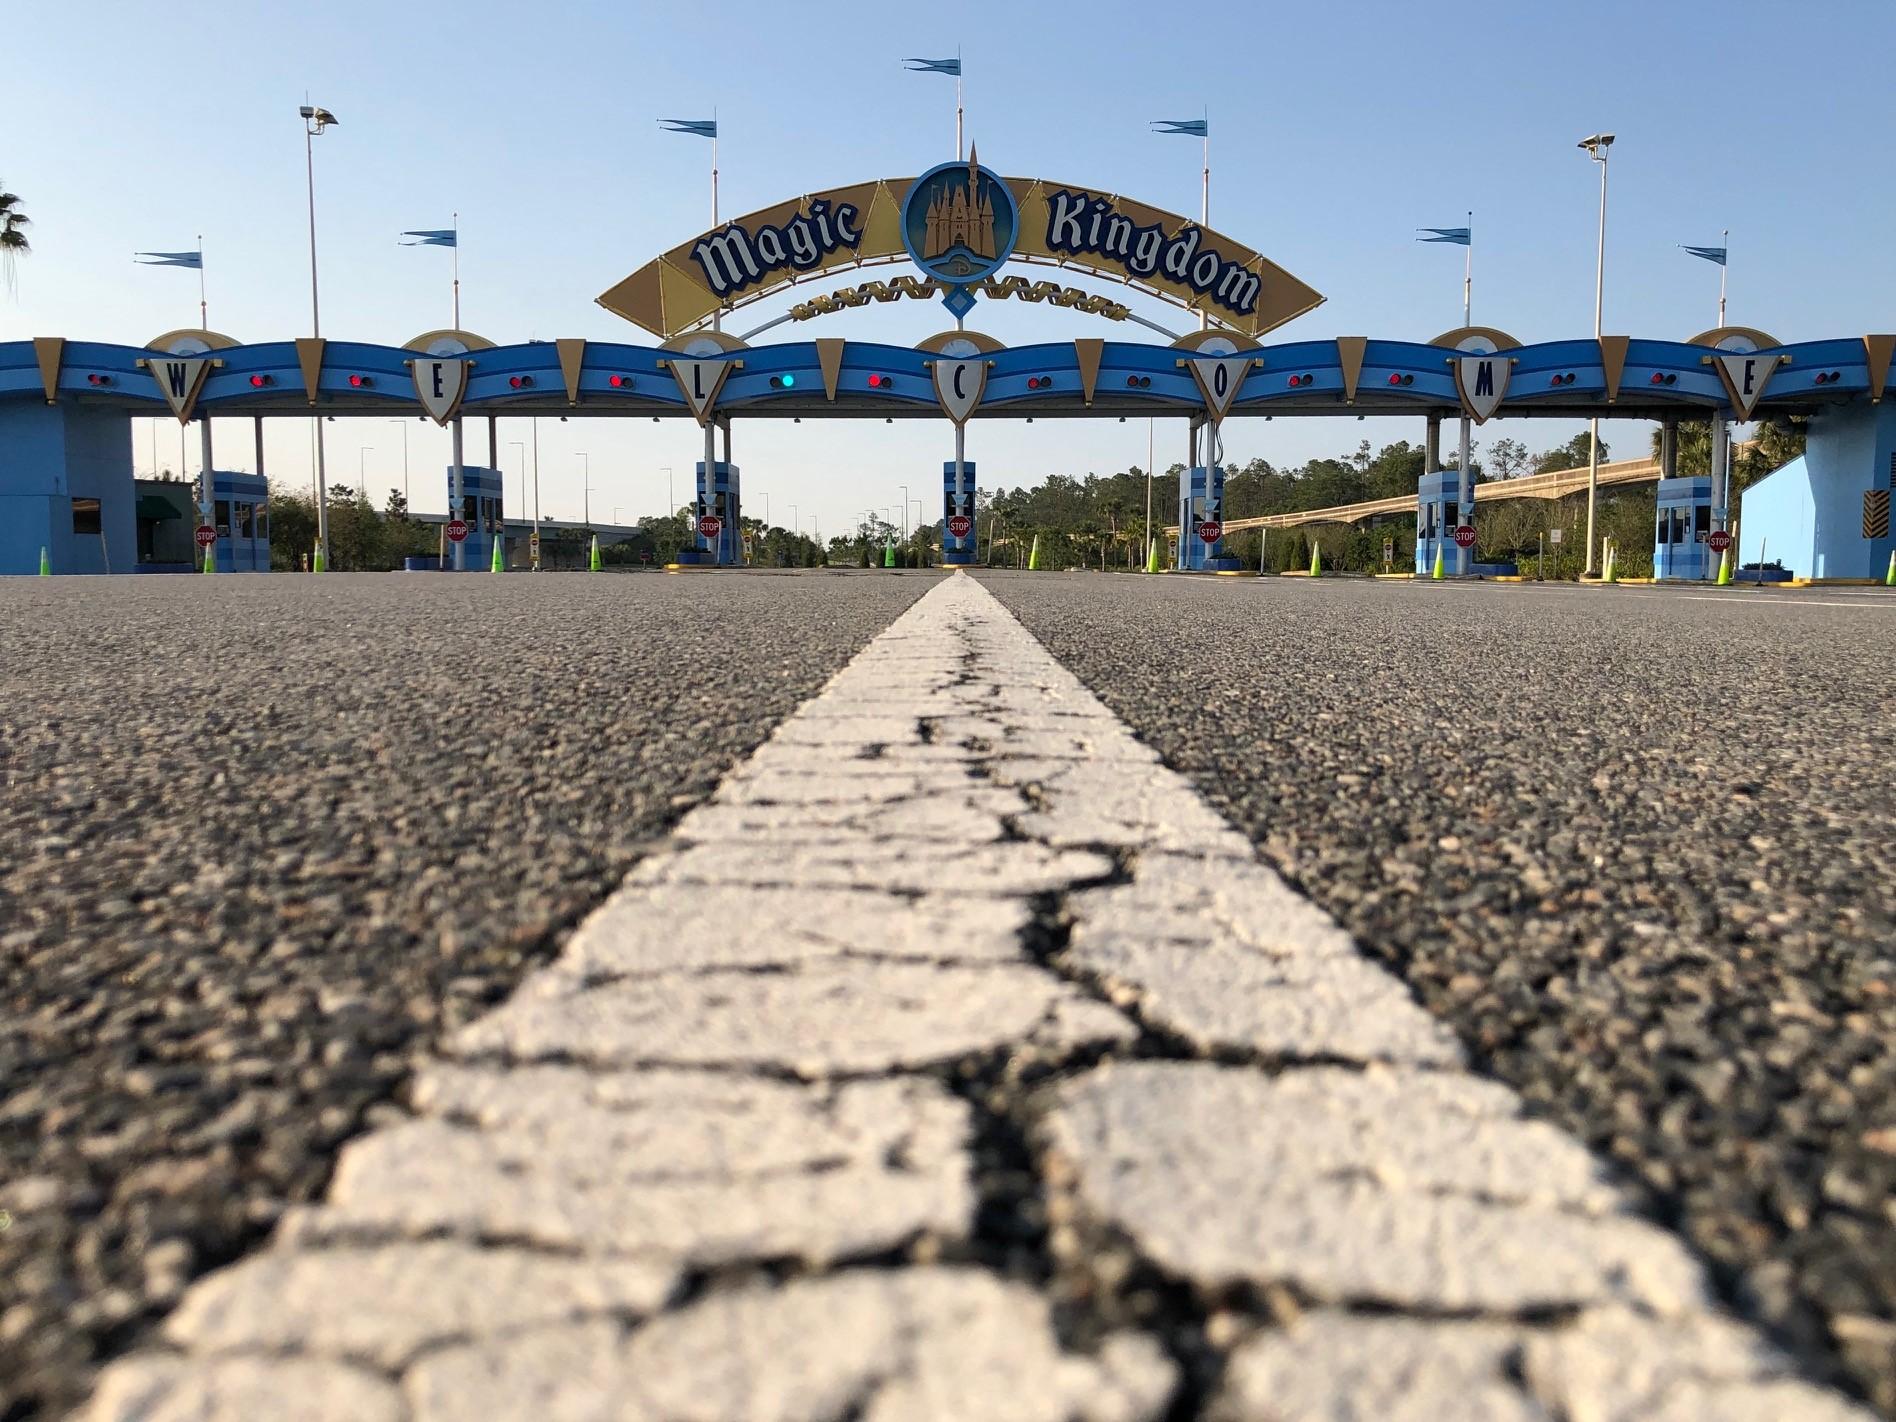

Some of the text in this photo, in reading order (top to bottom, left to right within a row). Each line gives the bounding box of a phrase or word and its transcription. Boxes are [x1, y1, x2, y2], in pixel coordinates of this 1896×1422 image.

[695, 190, 1262, 311] Magic Kingdom
[167, 359, 1756, 400] W E L C O M E
[447, 526, 467, 535] STOP
[700, 522, 719, 531] STOP
[950, 522, 969, 531] STOP
[197, 532, 215, 540] STOP
[1200, 528, 1220, 537] STOP
[1455, 532, 1475, 541] STOP
[1710, 537, 1730, 546] STOP
